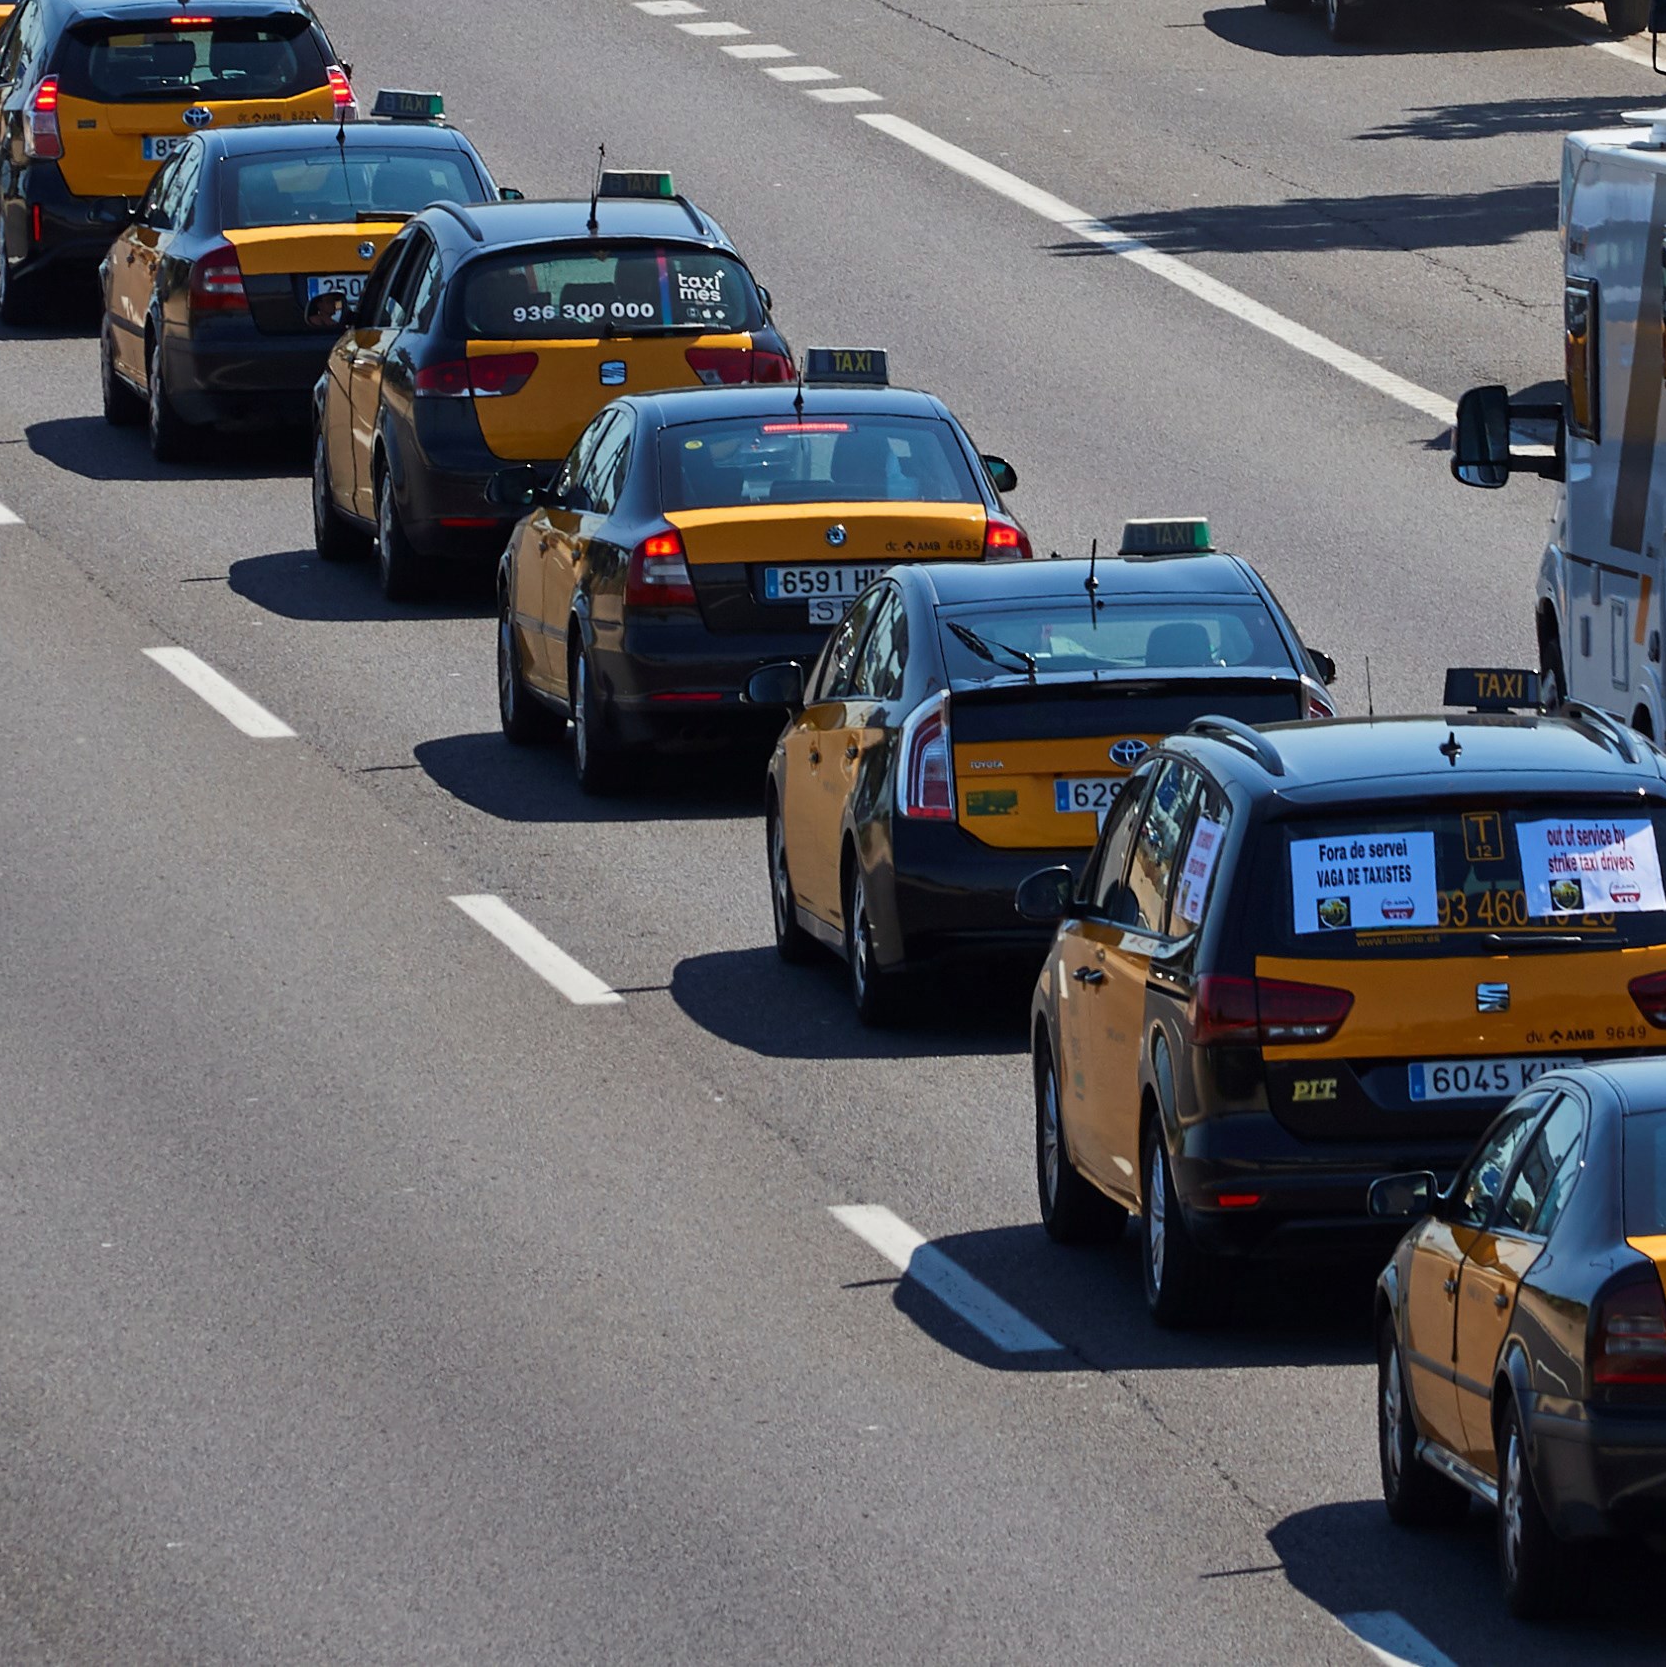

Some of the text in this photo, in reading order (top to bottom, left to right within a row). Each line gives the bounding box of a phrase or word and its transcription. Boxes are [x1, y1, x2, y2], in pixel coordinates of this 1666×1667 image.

[322, 277, 369, 298] 250
[677, 272, 721, 291] taxi
[512, 302, 655, 322] 936 300 000
[833, 352, 872, 372] TAXI
[916, 541, 941, 551] AMB
[947, 539, 981, 551] 4635
[1153, 524, 1192, 545] TAXI
[782, 570, 844, 594] 6591
[1474, 672, 1523, 698] TAXI
[970, 760, 1004, 769] TOYOTA
[1469, 815, 1493, 843] T
[1546, 823, 1627, 850] out of service by
[1318, 838, 1408, 862] Fora de servei
[1475, 845, 1492, 857] 12
[1548, 851, 1636, 874] strike taxi drivers
[1316, 864, 1412, 889] VAGA DE TAXISTES
[1438, 889, 1468, 927] 93
[1477, 890, 1529, 926] 460
[1564, 1028, 1595, 1042] AMB
[1605, 1026, 1647, 1041] 9649
[1433, 1063, 1510, 1094] 6045
